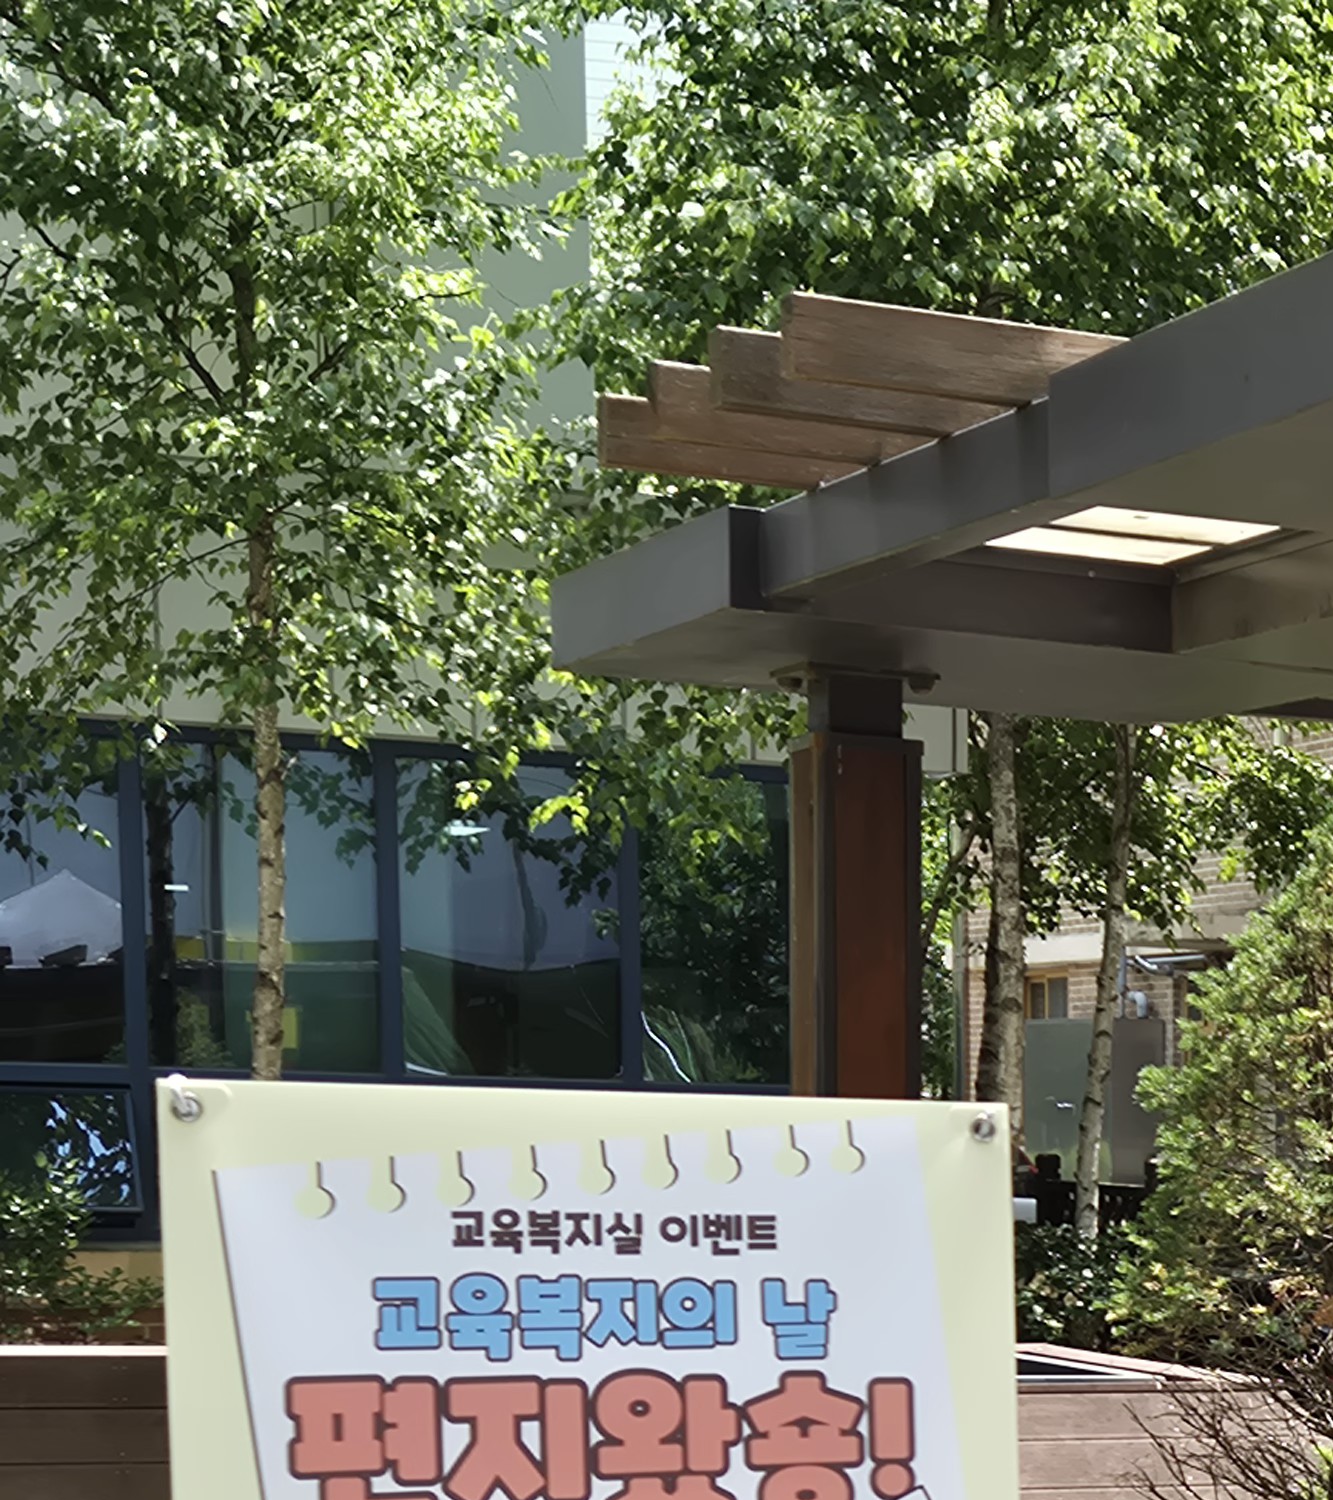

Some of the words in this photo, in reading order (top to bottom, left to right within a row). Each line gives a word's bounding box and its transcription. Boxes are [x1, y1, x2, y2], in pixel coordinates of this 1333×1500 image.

[450, 1208, 643, 1256] 교육복지실
[658, 1213, 778, 1256] 이벤트
[372, 1271, 738, 1362] 교육복지의
[760, 1277, 837, 1361] 날
